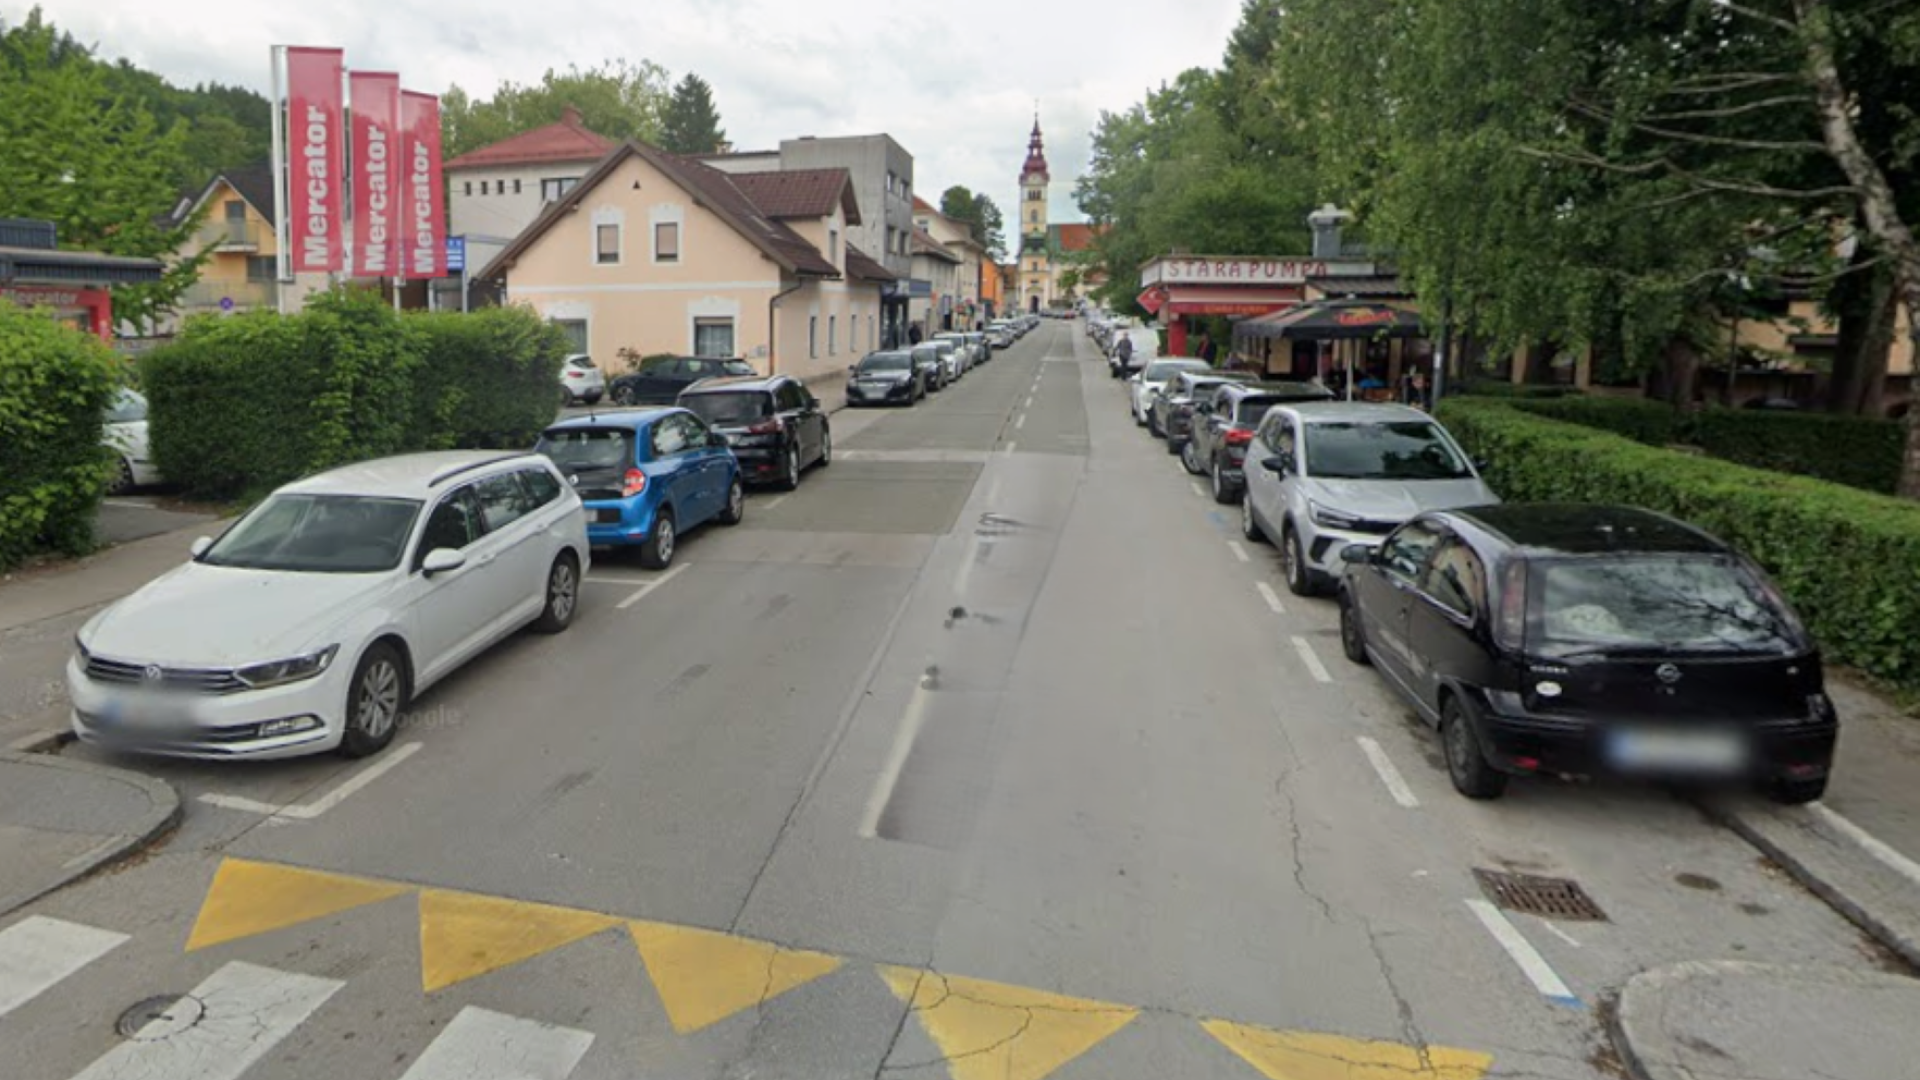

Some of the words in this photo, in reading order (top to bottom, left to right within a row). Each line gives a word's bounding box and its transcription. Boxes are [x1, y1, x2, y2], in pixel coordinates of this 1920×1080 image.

[304, 105, 328, 266] Mercator
[365, 125, 387, 272] Mercator
[412, 141, 435, 273] Mercator
[1168, 259, 1242, 278] STARA
[1249, 258, 1328, 278] PUMPA
